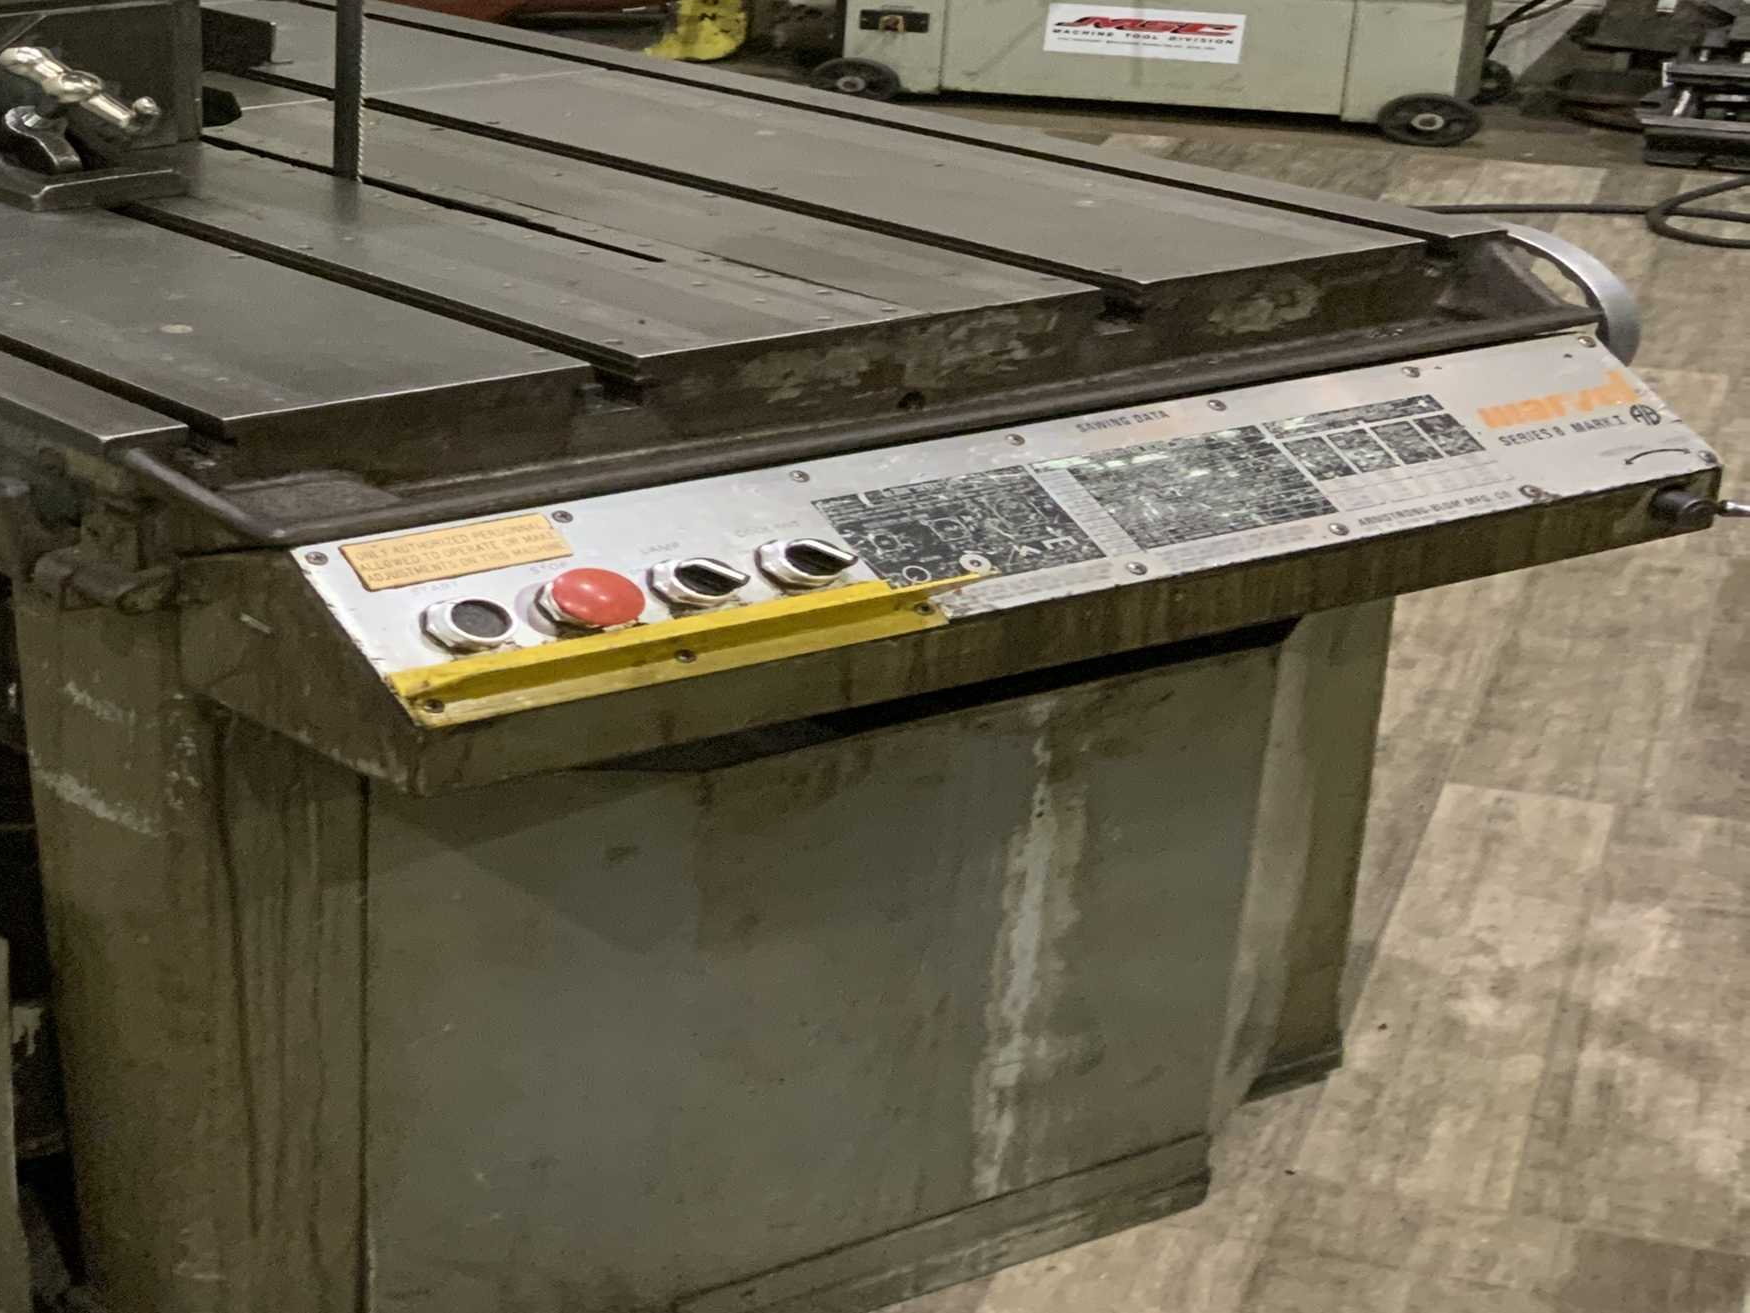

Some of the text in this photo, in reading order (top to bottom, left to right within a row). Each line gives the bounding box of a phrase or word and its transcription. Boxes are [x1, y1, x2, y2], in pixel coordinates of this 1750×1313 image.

[1052, 28, 1115, 38] MACHINE
[1125, 32, 1159, 42] TOOL
[1168, 35, 1235, 46] DIVISION
[1075, 410, 1170, 433] SAWING DATA
[1498, 427, 1553, 447] SERIES
[1570, 417, 1613, 434] MARK
[360, 555, 420, 572] ALLOWED
[443, 541, 499, 558] OPERATE
